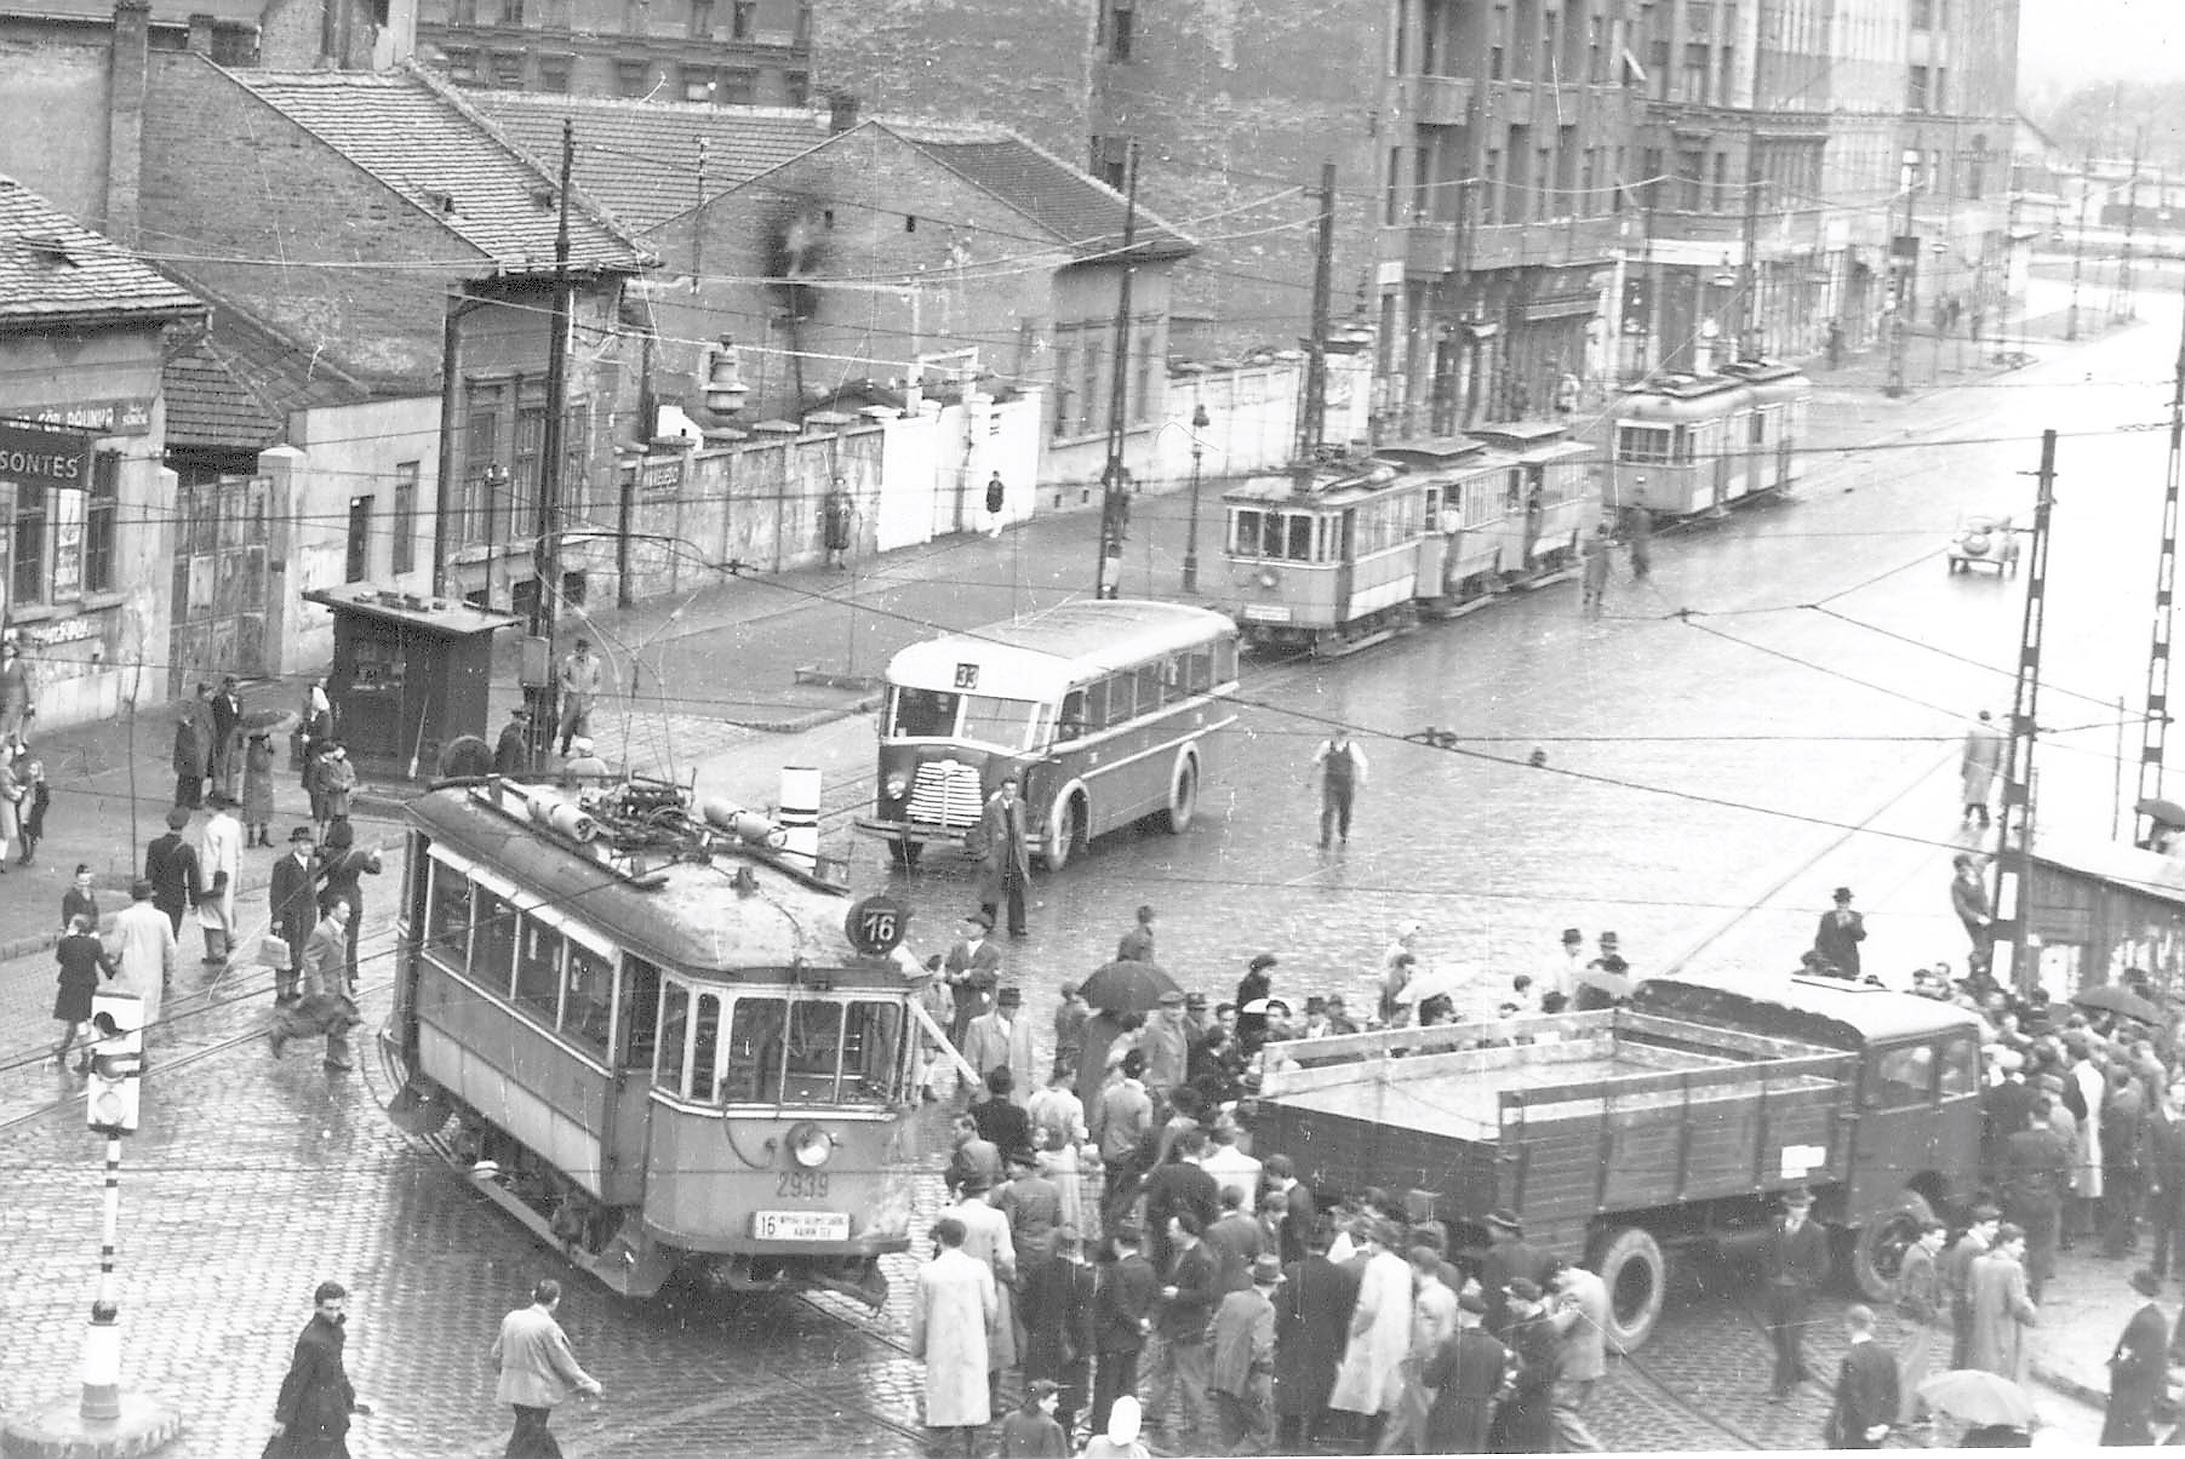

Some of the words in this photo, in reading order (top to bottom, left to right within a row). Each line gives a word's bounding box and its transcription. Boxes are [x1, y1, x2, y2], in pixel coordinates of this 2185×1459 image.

[957, 666, 978, 688] 33
[865, 914, 895, 941] 16
[776, 1171, 829, 1198] 2939
[761, 1215, 776, 1236] 16
